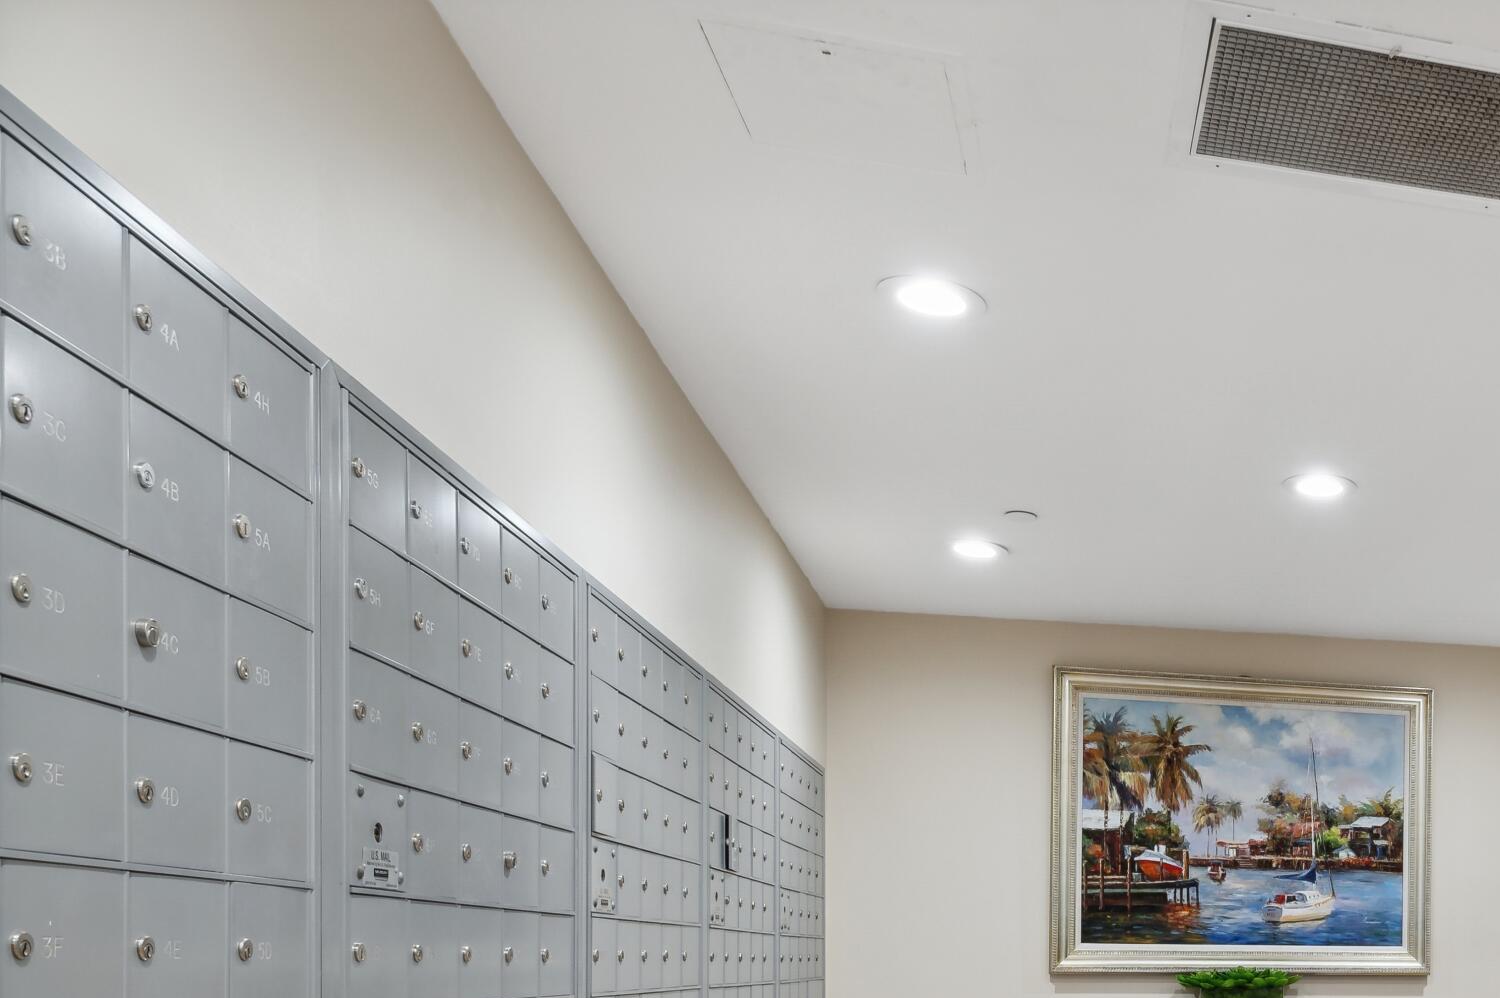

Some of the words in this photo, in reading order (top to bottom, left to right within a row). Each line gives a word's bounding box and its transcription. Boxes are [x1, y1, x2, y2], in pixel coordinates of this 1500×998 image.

[160, 323, 180, 353] 4A
[254, 391, 270, 415] 4H
[160, 478, 179, 502] 4B
[367, 468, 379, 489] 5G
[255, 527, 271, 552] 5A
[42, 587, 65, 614] 3D
[369, 587, 381, 608] 5H
[160, 631, 179, 654] 4C
[255, 666, 271, 687] 5B
[42, 762, 65, 787] 3E
[160, 786, 179, 807] 4D
[255, 804, 272, 823] 5C
[41, 936, 64, 959] 3F
[163, 940, 183, 959] 4E
